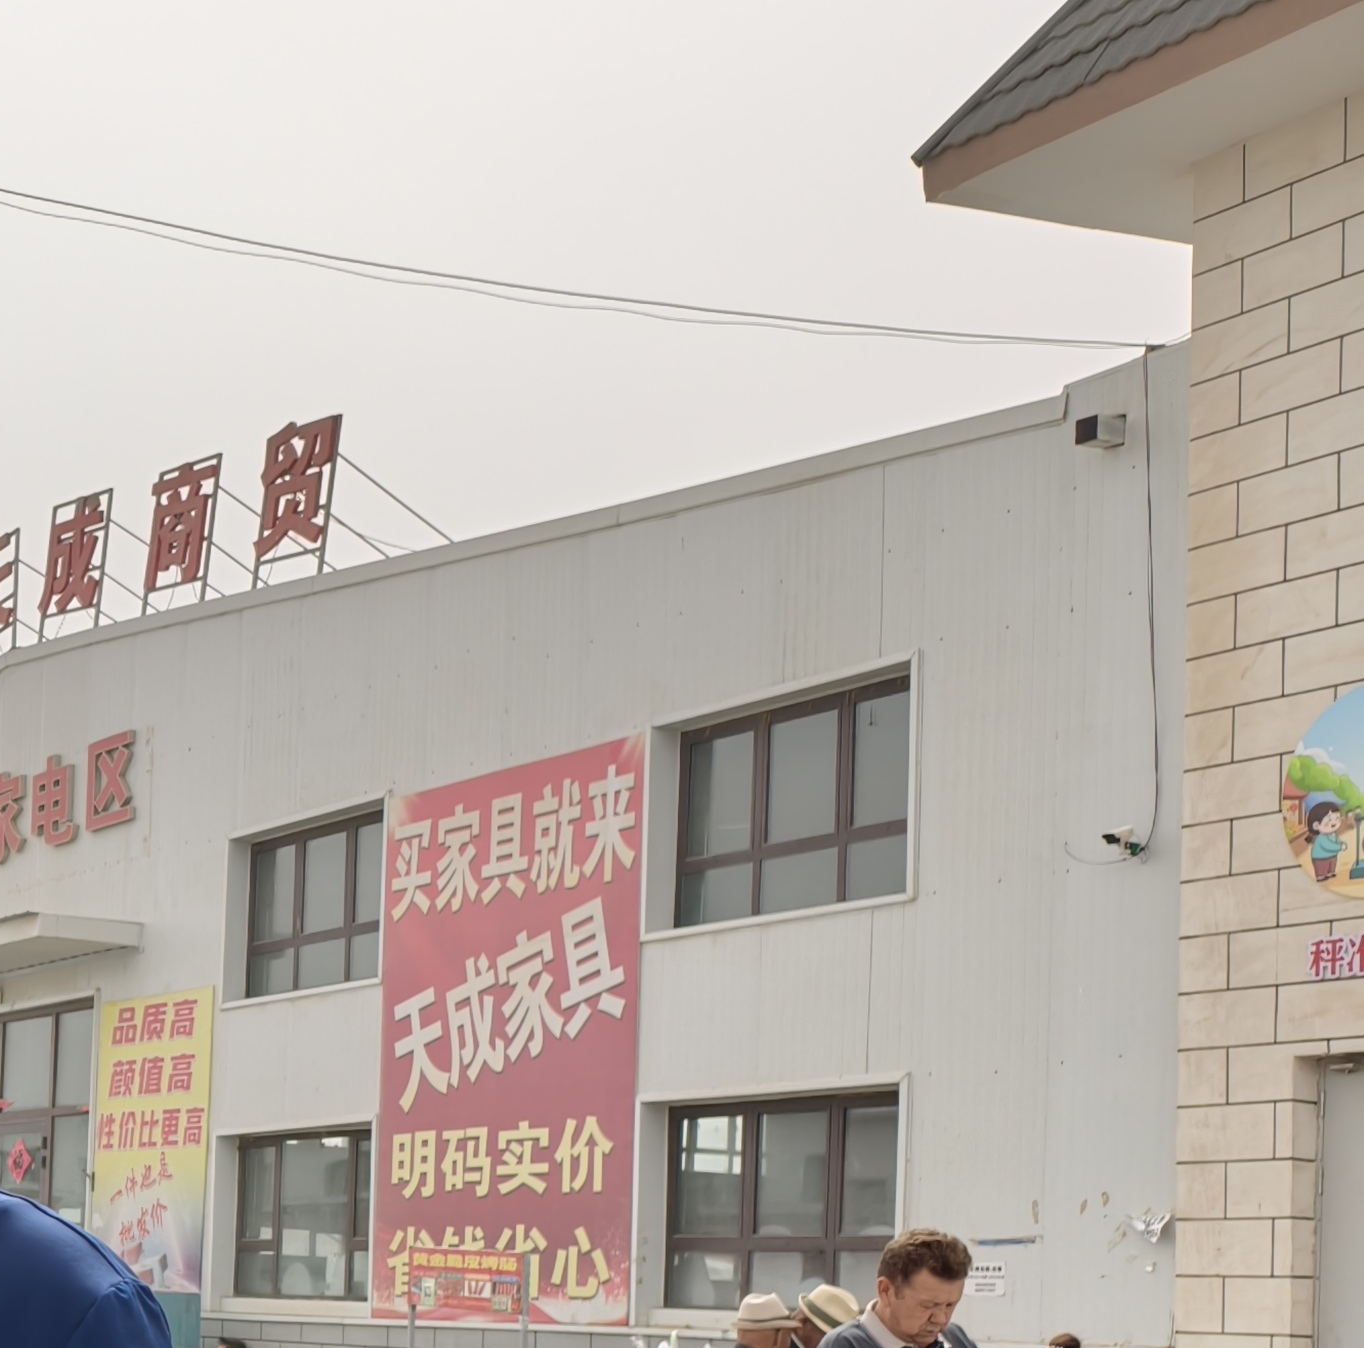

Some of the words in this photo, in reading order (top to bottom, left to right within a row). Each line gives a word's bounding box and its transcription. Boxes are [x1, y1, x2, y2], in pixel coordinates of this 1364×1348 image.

[391, 765, 637, 923] 买家具就来
[111, 999, 198, 1046] 品质高
[393, 897, 627, 1114] 天成家具
[108, 1053, 195, 1098] 颜值高
[97, 1107, 205, 1150] 性价比更高
[390, 1115, 614, 1200] 明码实价
